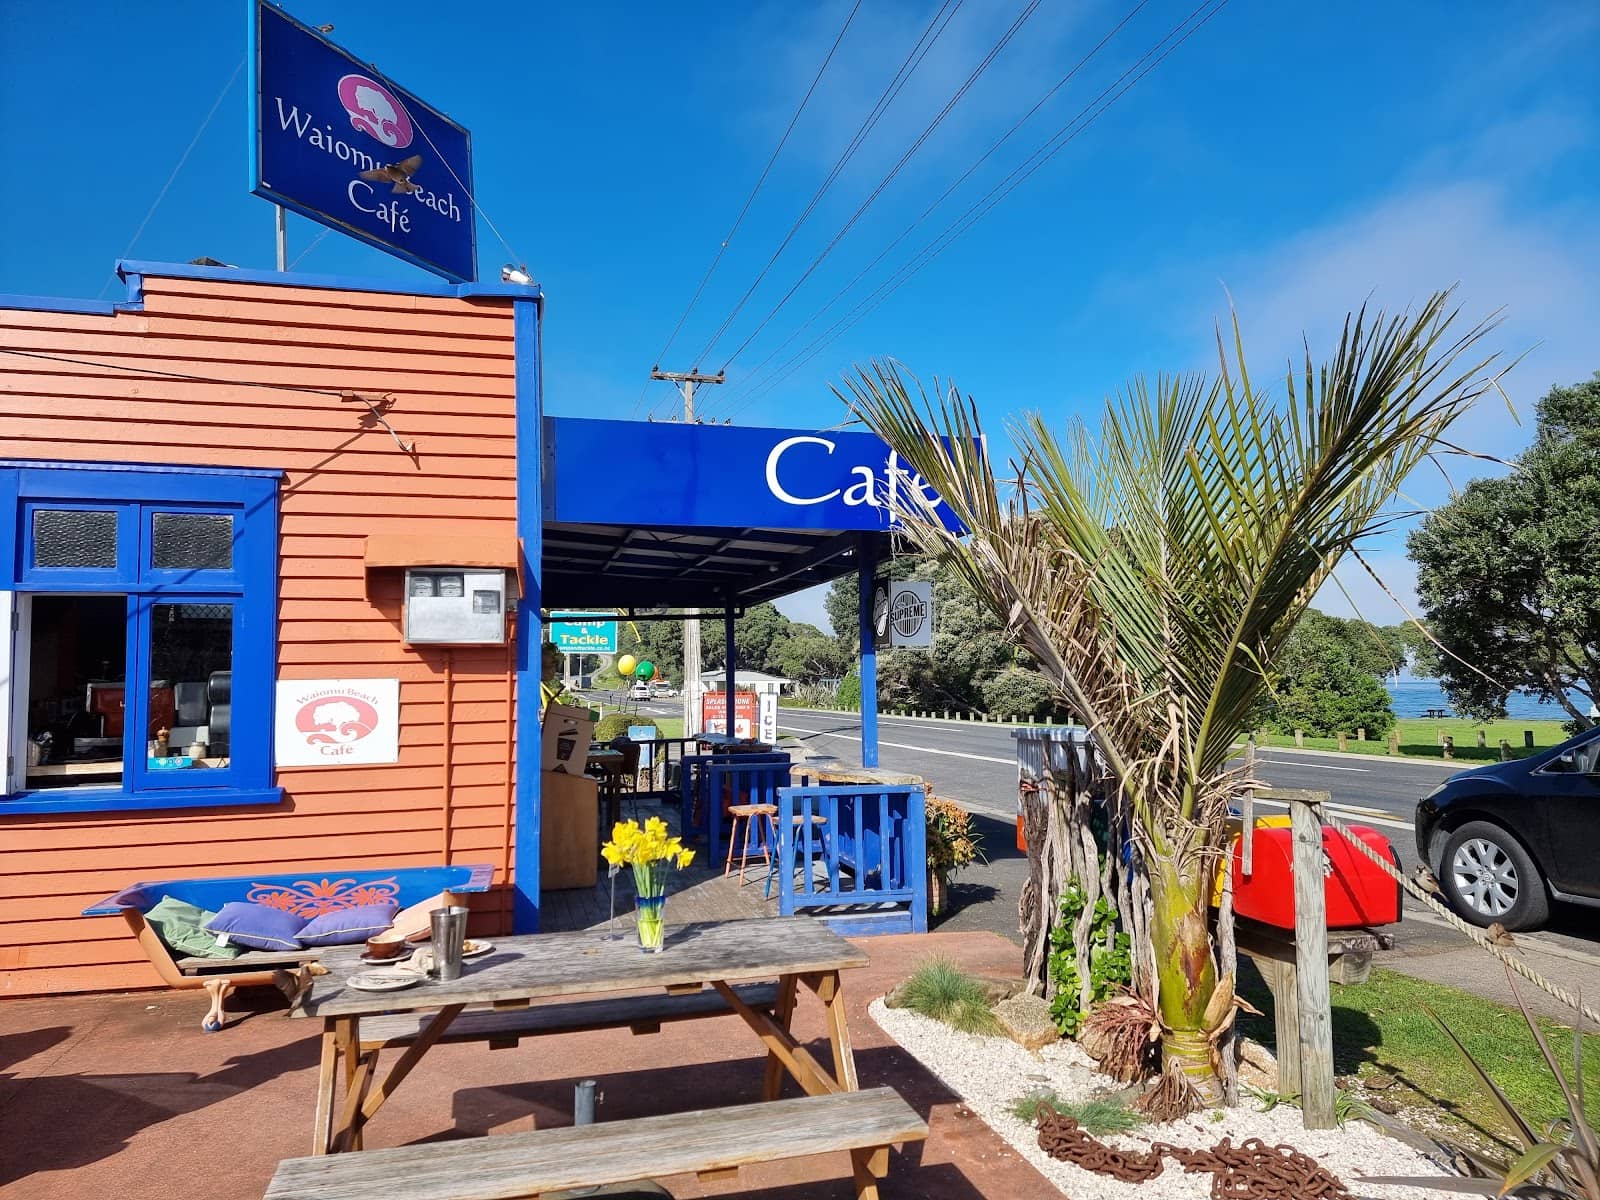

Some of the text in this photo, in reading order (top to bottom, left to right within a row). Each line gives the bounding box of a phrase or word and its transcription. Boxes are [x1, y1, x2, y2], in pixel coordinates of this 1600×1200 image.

[348, 180, 411, 233] Café
[396, 163, 461, 223] each
[889, 603, 925, 624] SUPREME
[560, 634, 609, 645] Tackle
[347, 688, 379, 705] Beach
[763, 700, 773, 740] ICE
